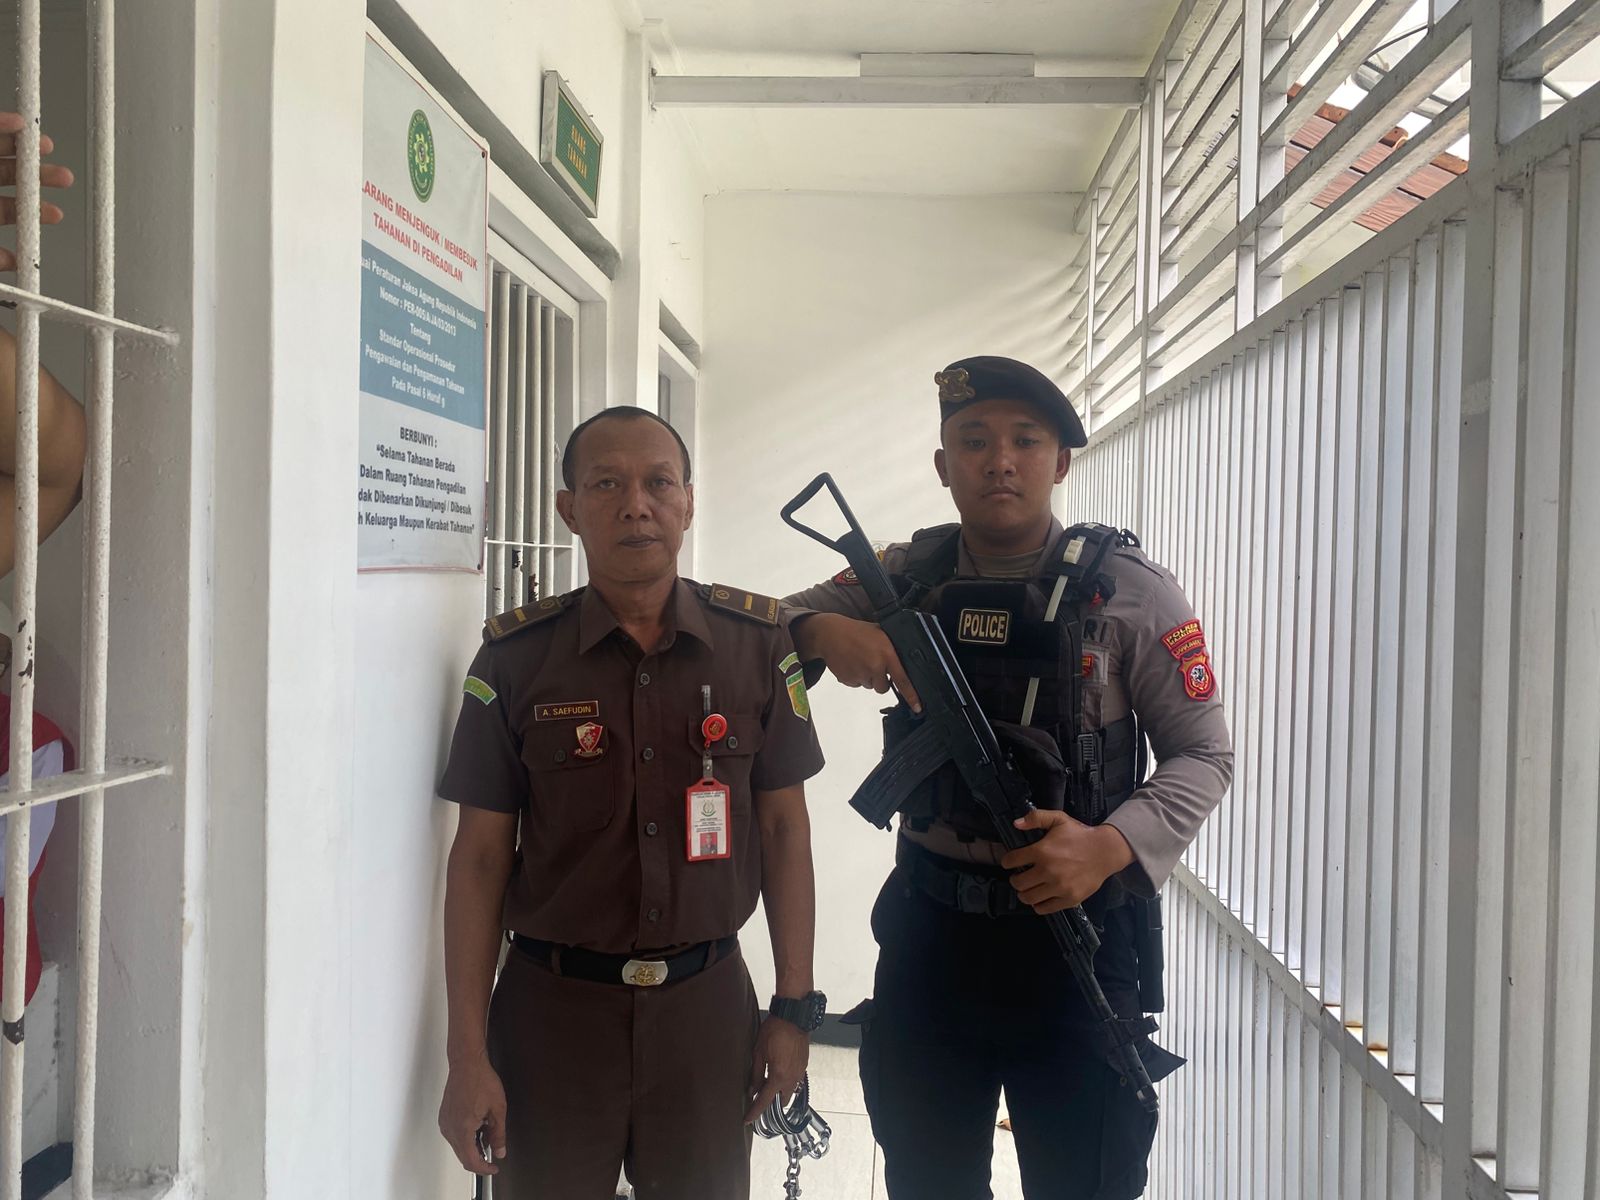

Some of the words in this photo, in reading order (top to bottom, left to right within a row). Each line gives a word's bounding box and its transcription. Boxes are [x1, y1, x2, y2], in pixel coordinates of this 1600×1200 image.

[373, 212, 411, 249] TAHANAN
[412, 240, 420, 255] DI
[421, 246, 463, 282] PENGADILAN
[395, 202, 440, 245] MENJENGUK
[444, 238, 478, 271] MEMBESUK
[372, 260, 401, 288] Peraturan
[402, 278, 418, 297] Jaksa
[419, 288, 435, 309] Agung
[436, 297, 456, 319] Republik
[456, 309, 477, 330] Indonesia
[380, 286, 399, 307] Nomor
[410, 322, 431, 345] Tentang
[379, 329, 402, 348] Standar
[403, 340, 434, 363] Operasional
[434, 354, 456, 373] Prosedur
[365, 344, 401, 369] Pengawalan
[402, 361, 412, 374] dan
[413, 364, 445, 386] Pengamanan
[446, 378, 465, 395] Tahanan
[392, 376, 406, 391] Pada
[407, 381, 422, 398] Pasal
[422, 388, 426, 400] 6
[400, 427, 434, 448] BERBUNYI
[407, 450, 434, 469] Tahanan
[434, 458, 456, 473] Berada
[360, 464, 384, 481] Dalam
[385, 468, 407, 487] Ruang
[408, 474, 435, 489] Tahanan
[436, 478, 466, 496] Pengadilan
[374, 490, 414, 506] Dibenarkan
[415, 495, 447, 514] Dikunjungi
[450, 501, 472, 516] Dibesuk
[365, 512, 398, 530] Keluarga
[399, 514, 424, 531] Maupun
[426, 517, 449, 533] Kerabat
[963, 614, 1006, 638] POLICE
[552, 706, 592, 716] SAEFUDIN
